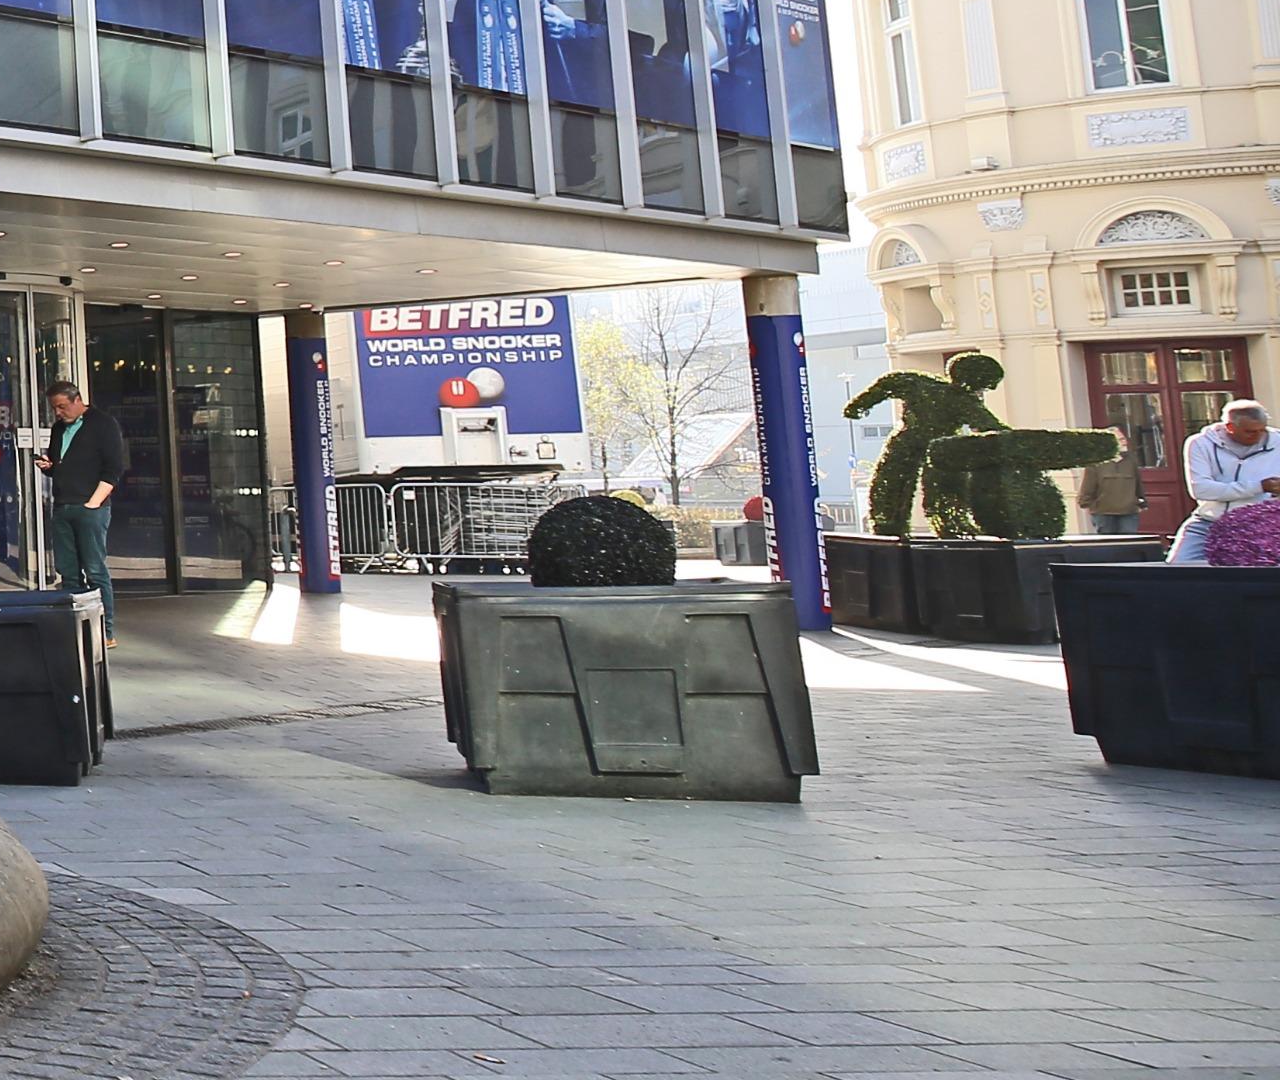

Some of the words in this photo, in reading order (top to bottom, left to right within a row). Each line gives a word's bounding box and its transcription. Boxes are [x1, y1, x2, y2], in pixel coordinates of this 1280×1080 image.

[370, 298, 555, 332] BETFRED
[366, 337, 446, 353] WORLD
[451, 334, 562, 351] SNOOKER
[368, 350, 563, 367] CHAMPIONSHIP
[316, 380, 328, 434] SNOOKER
[799, 367, 812, 434] SNOOKER
[753, 366, 771, 486] CHAMPIONSHIP
[320, 437, 330, 478] WORLD
[806, 438, 818, 487] WORLD
